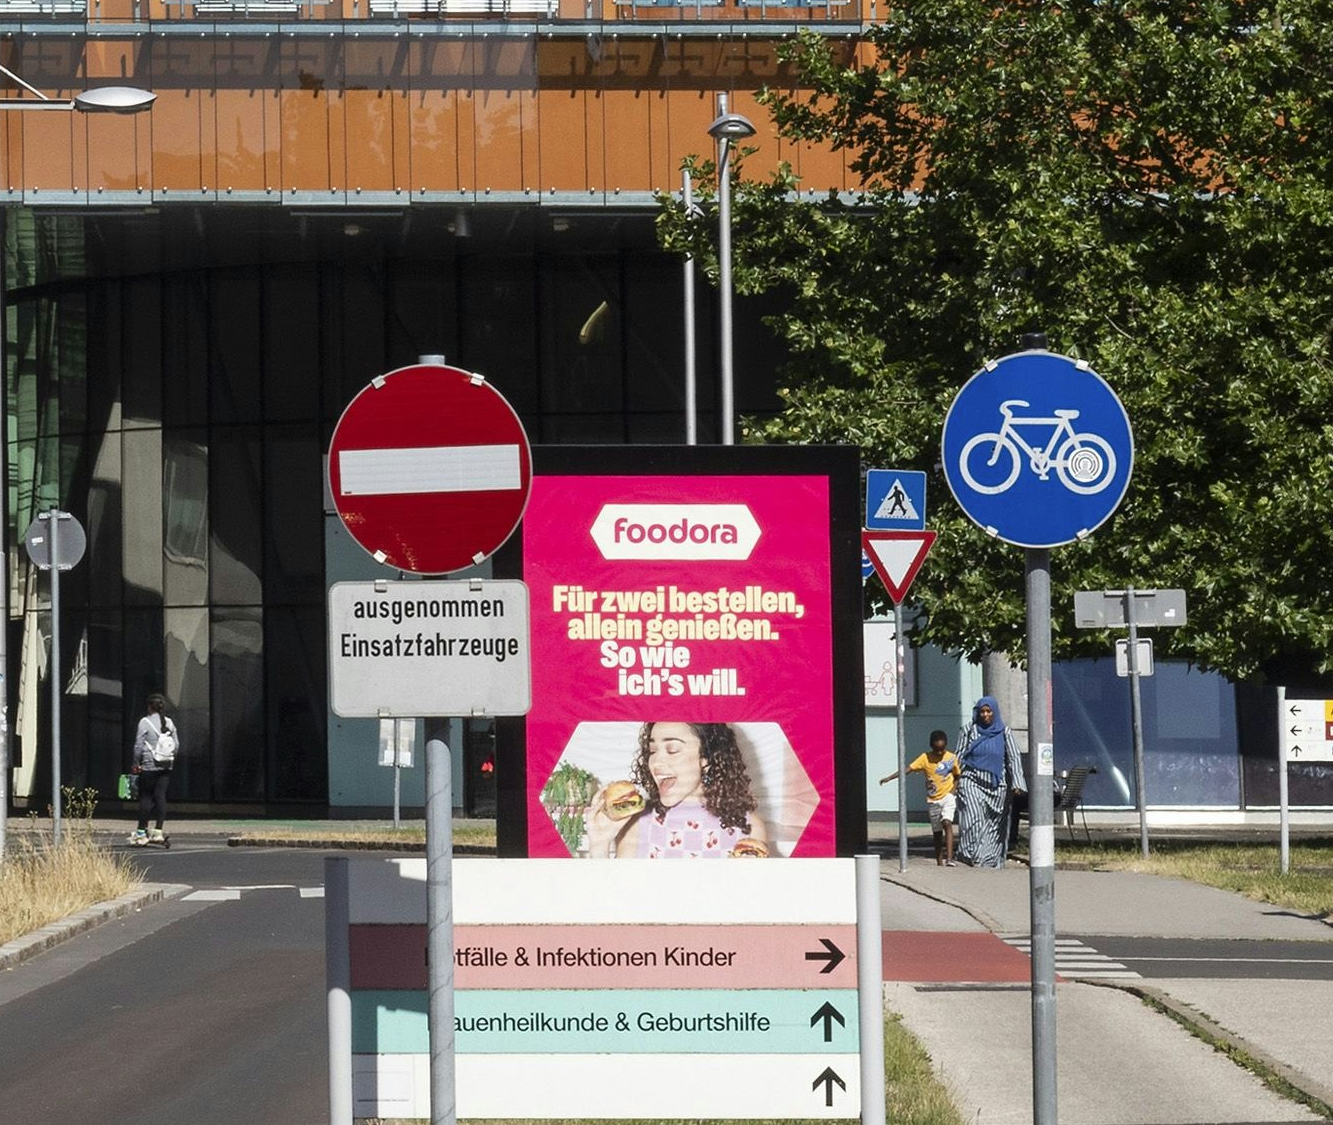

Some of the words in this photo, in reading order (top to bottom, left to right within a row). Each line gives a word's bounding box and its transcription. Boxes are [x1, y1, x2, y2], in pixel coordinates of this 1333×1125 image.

[614, 518, 738, 545] foodora
[353, 599, 505, 625] ausgenommen
[552, 586, 597, 614] Für
[600, 586, 665, 613] zwei
[669, 586, 804, 618] bestellen,
[568, 614, 643, 641] allein
[646, 614, 779, 646] genießen.
[341, 632, 519, 663] Einsatzfahrzeuge
[601, 641, 636, 668] So
[639, 641, 690, 668] wie
[687, 670, 745, 696] will.
[425, 946, 508, 967] tfälle
[514, 946, 530, 967] &
[536, 947, 657, 967] Infektionen
[664, 946, 737, 967] Kinder
[453, 1012, 609, 1032] auenheilkunde
[614, 1012, 631, 1032] &
[637, 1011, 771, 1032] Geburtshilfe
